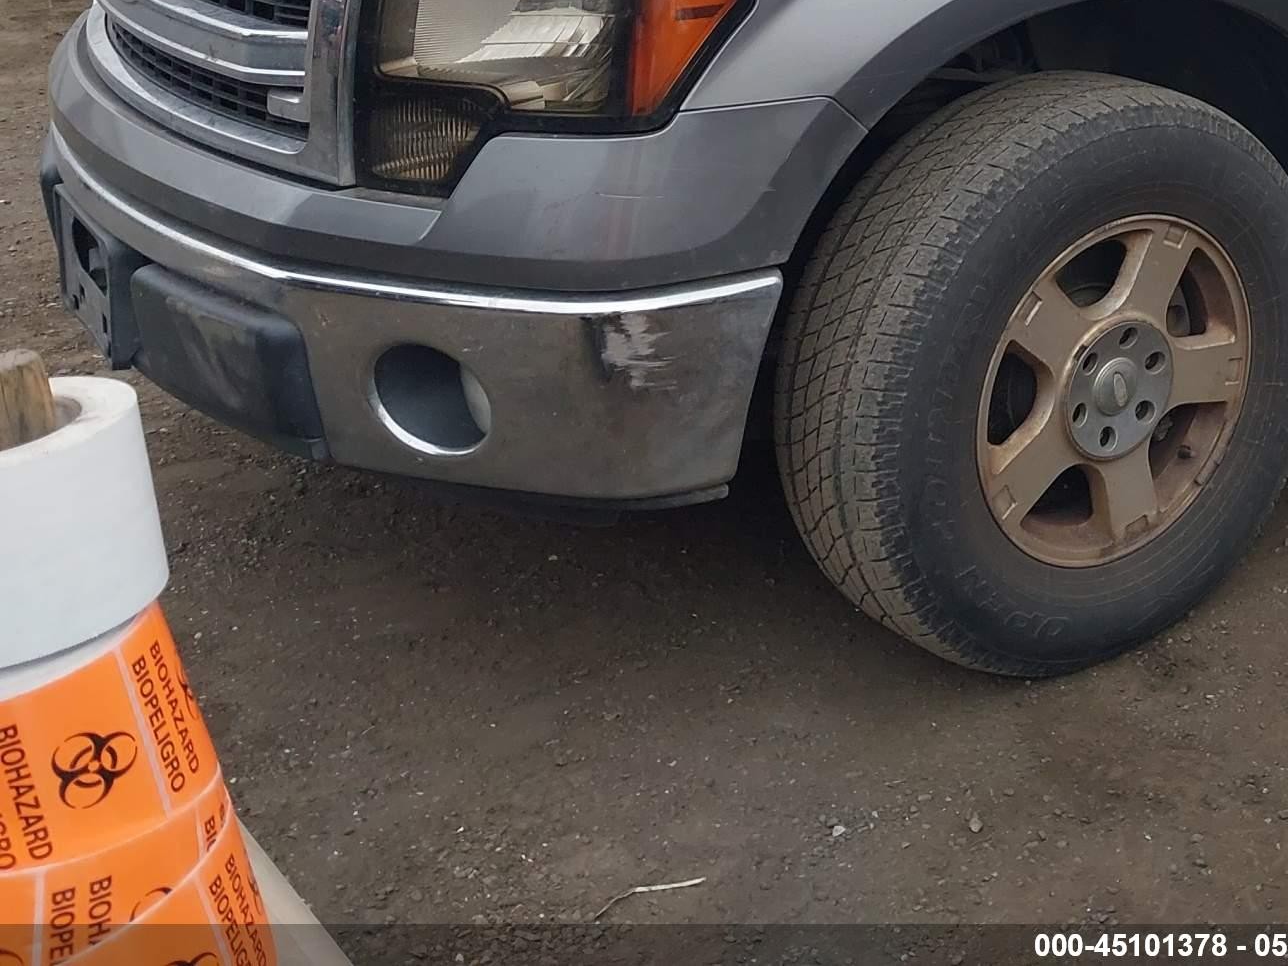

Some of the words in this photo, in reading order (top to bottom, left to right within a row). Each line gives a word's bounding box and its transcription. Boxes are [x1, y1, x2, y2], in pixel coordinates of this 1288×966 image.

[131, 655, 186, 793] BIOPELIGRO
[149, 640, 200, 775] BIOHAZARD
[0, 723, 53, 861] BIOHAZARD
[49, 887, 76, 966] BIOPE
[88, 875, 113, 946] BIOH
[208, 875, 251, 966] BIOPELIG
